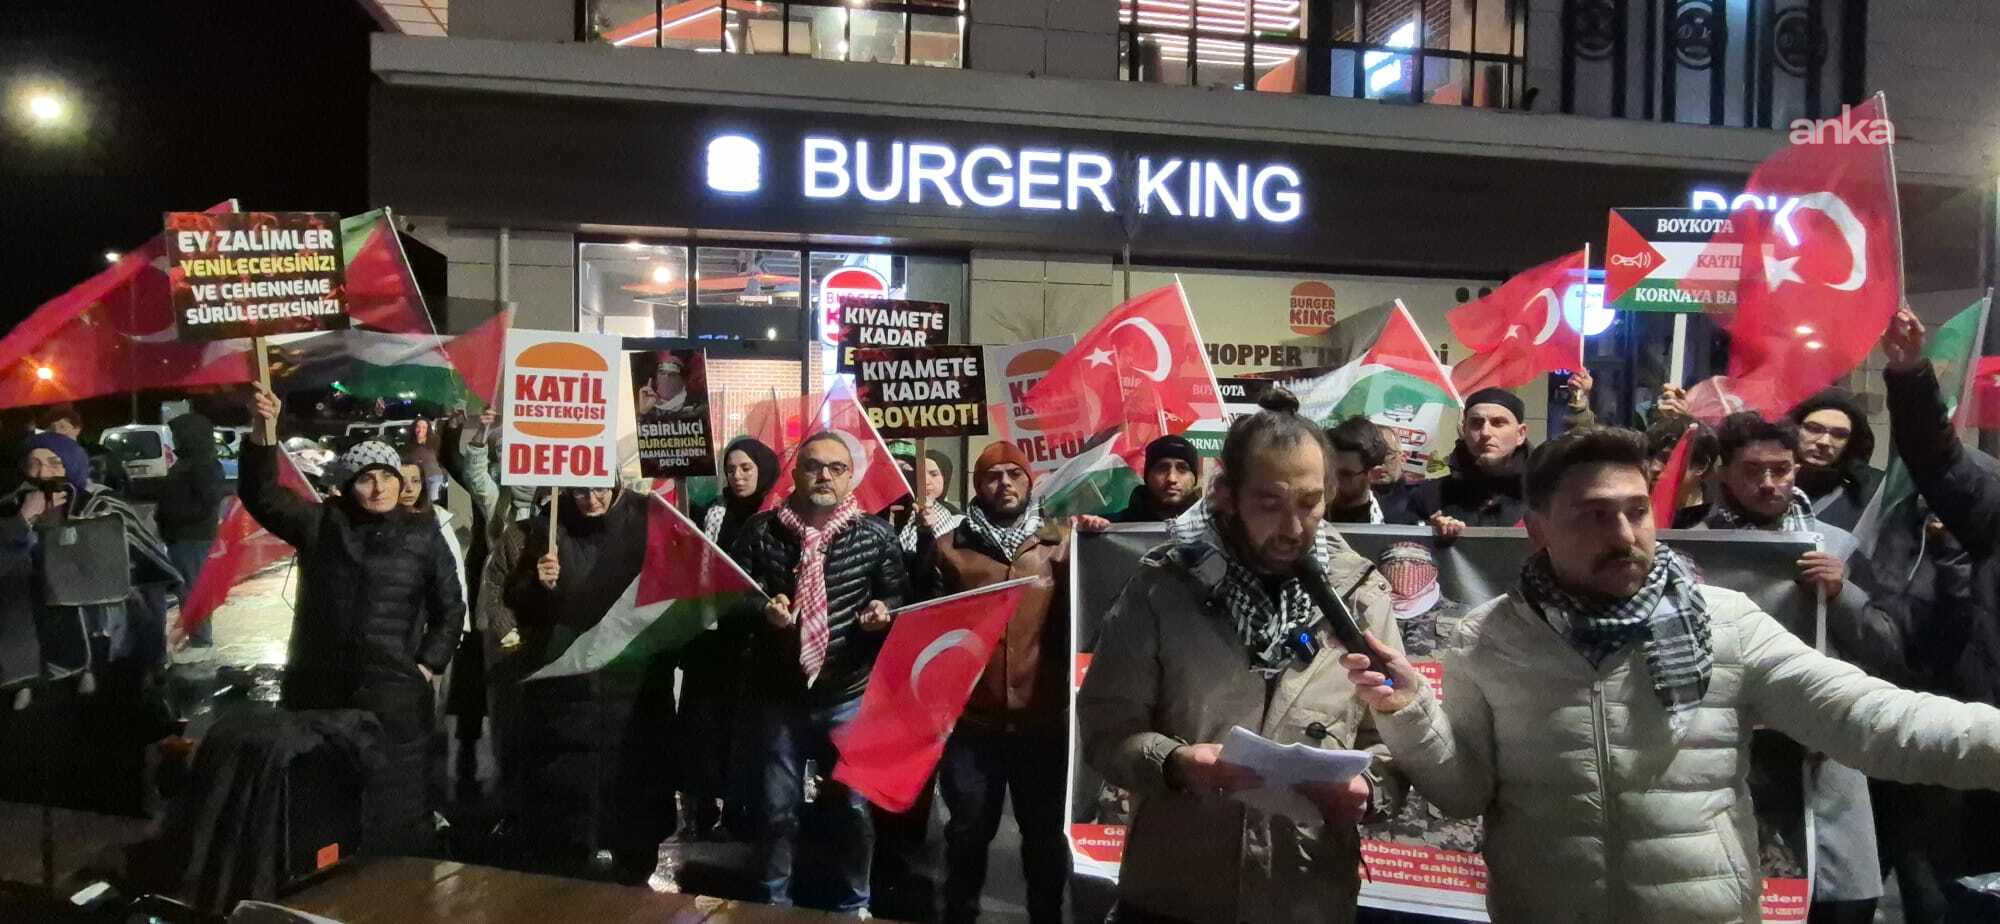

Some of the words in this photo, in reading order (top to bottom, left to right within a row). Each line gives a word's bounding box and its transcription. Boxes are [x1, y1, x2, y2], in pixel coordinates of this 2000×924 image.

[803, 137, 1115, 212] BURGER
[1136, 156, 1302, 222] KING
[1656, 218, 1734, 234] BOYKOTA
[178, 231, 209, 252] EY
[217, 225, 335, 252] ZALİMLER
[180, 252, 336, 277] YENİLECEKSİNİZ!
[192, 284, 217, 301] VE
[222, 279, 330, 299] CEHENNEME
[1634, 287, 1712, 304] KORNAYA
[186, 297, 340, 325] SÜRÜLECEKSİNİZ!
[1290, 298, 1336, 310] BURGER
[845, 307, 944, 330] KIYAMETE
[1289, 309, 1337, 325] KING
[860, 327, 926, 347] KADAR
[862, 357, 978, 381] KIYAMETE
[515, 372, 607, 404] KATİL
[882, 380, 961, 401] KADAR
[514, 404, 605, 420] DESTEKÇİSİ
[868, 403, 979, 428] BOYKOT!
[509, 443, 608, 476] DEFOL
[1360, 842, 1429, 859] ubbenin
[1363, 853, 1414, 869] benin
